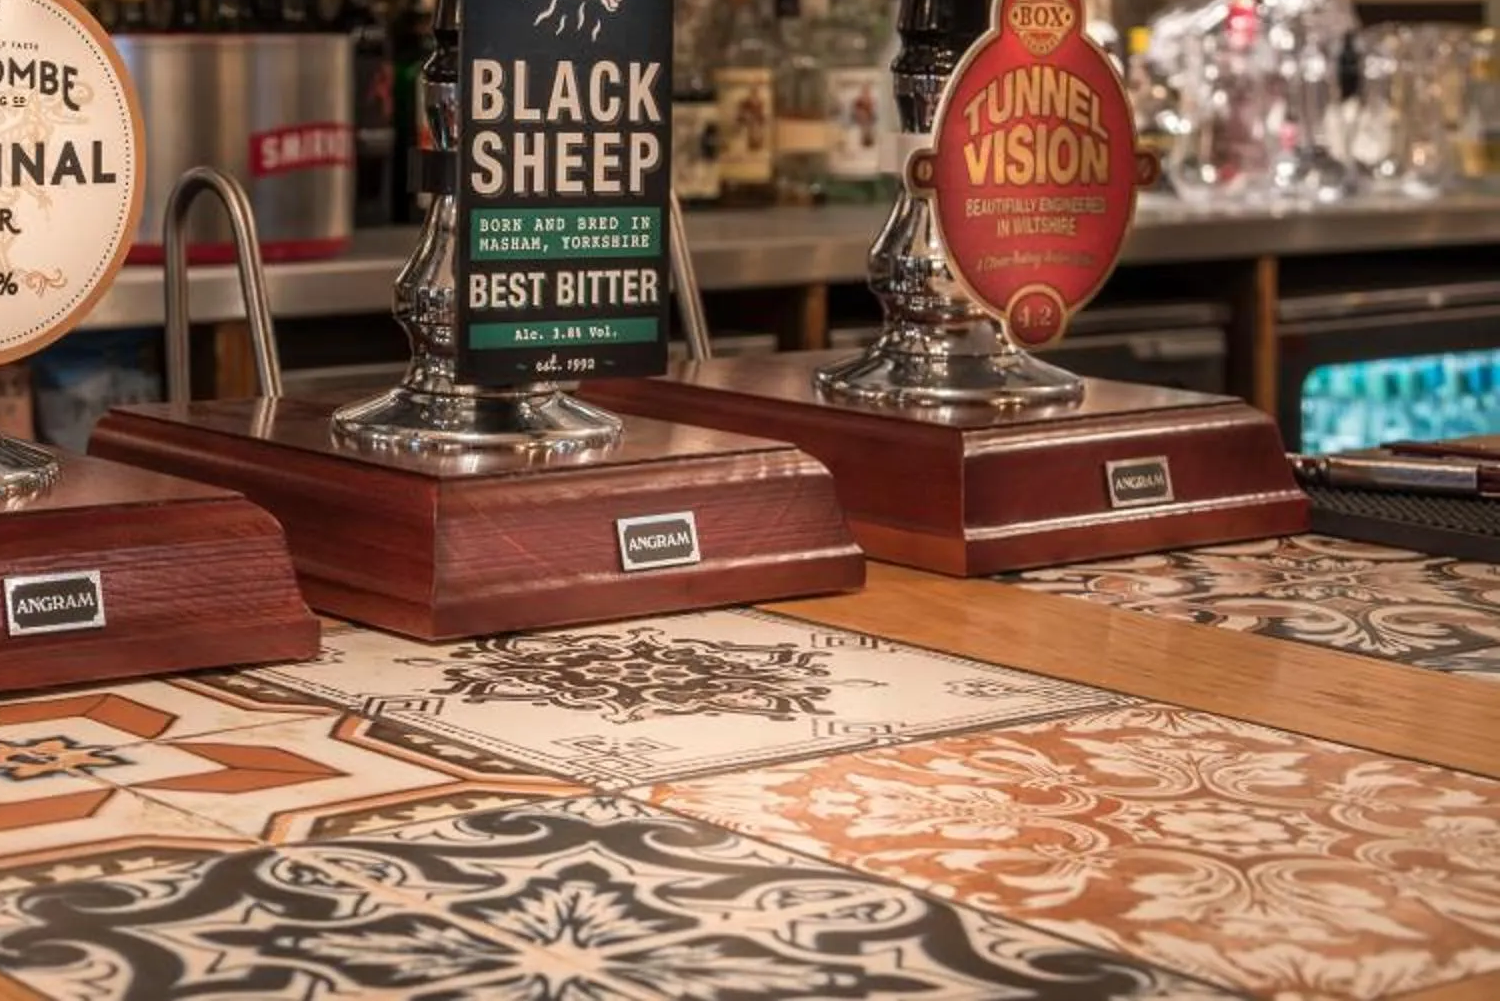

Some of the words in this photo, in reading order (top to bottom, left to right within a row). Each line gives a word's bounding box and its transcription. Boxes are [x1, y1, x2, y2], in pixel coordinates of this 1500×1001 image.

[1020, 6, 1064, 27] BOX
[471, 58, 661, 123] BLACK
[963, 64, 1109, 140] TUNNEL
[471, 130, 661, 197] SHEEP
[963, 123, 1109, 187] VISION
[479, 217, 522, 232] BORN
[534, 217, 565, 232] AND
[577, 216, 619, 231] BRED
[631, 216, 651, 230] IN
[997, 219, 1010, 238] IN
[1013, 217, 1077, 236] WILTSHIRE
[479, 235, 549, 253] MASHAM,
[561, 234, 650, 249] YORKSHIRE
[469, 272, 547, 309] BEST
[556, 268, 659, 307] BITTER
[515, 328, 544, 341] Alc.
[589, 324, 617, 339] Vol.
[536, 353, 563, 372] est.
[566, 358, 595, 372] 1992
[1115, 472, 1165, 491] ANGRAM
[628, 531, 690, 551] ANGRAM
[17, 592, 95, 614] ANGRAM
